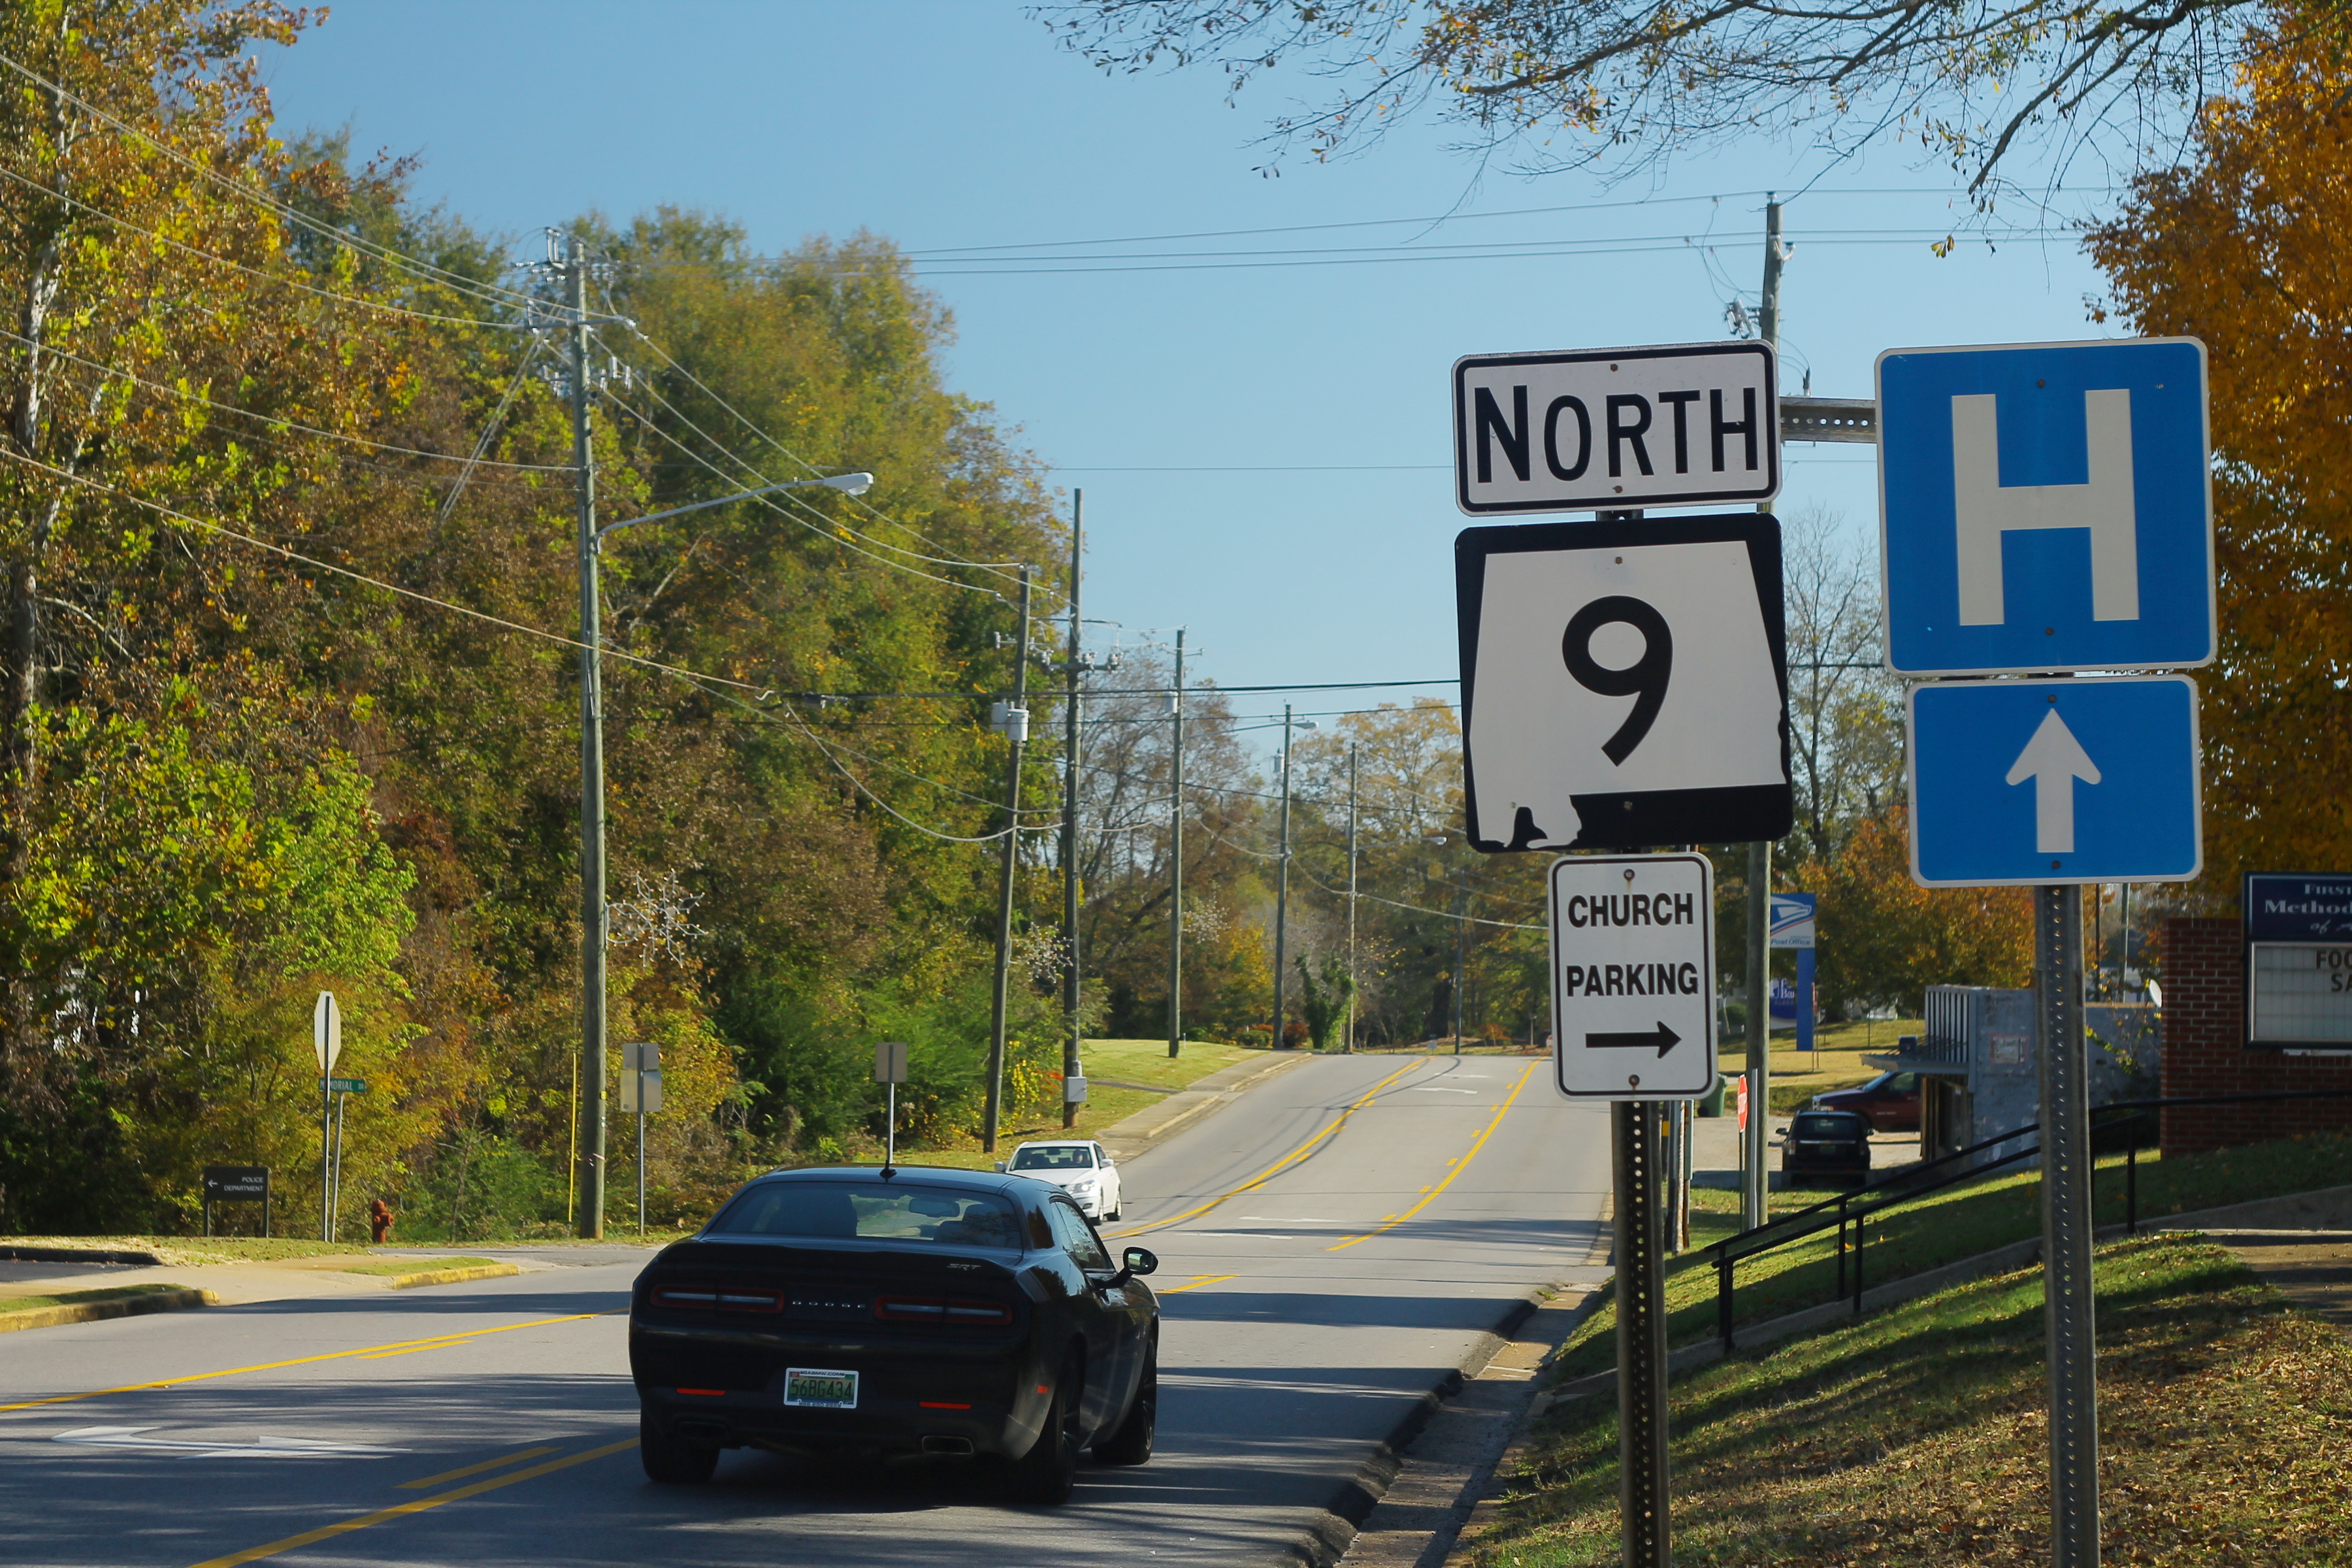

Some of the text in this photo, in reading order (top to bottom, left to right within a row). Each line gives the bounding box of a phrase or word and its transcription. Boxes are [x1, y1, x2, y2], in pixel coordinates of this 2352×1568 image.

[1474, 384, 1758, 483] NORTH
[1952, 388, 2140, 626] H
[1562, 595, 1673, 767] 9
[1568, 892, 1694, 928] CHURCH
[1566, 962, 1699, 998] PARKING
[319, 1080, 353, 1090] MMORIAL
[792, 1300, 866, 1309] DODGE
[791, 1379, 852, 1399] 56BG434
